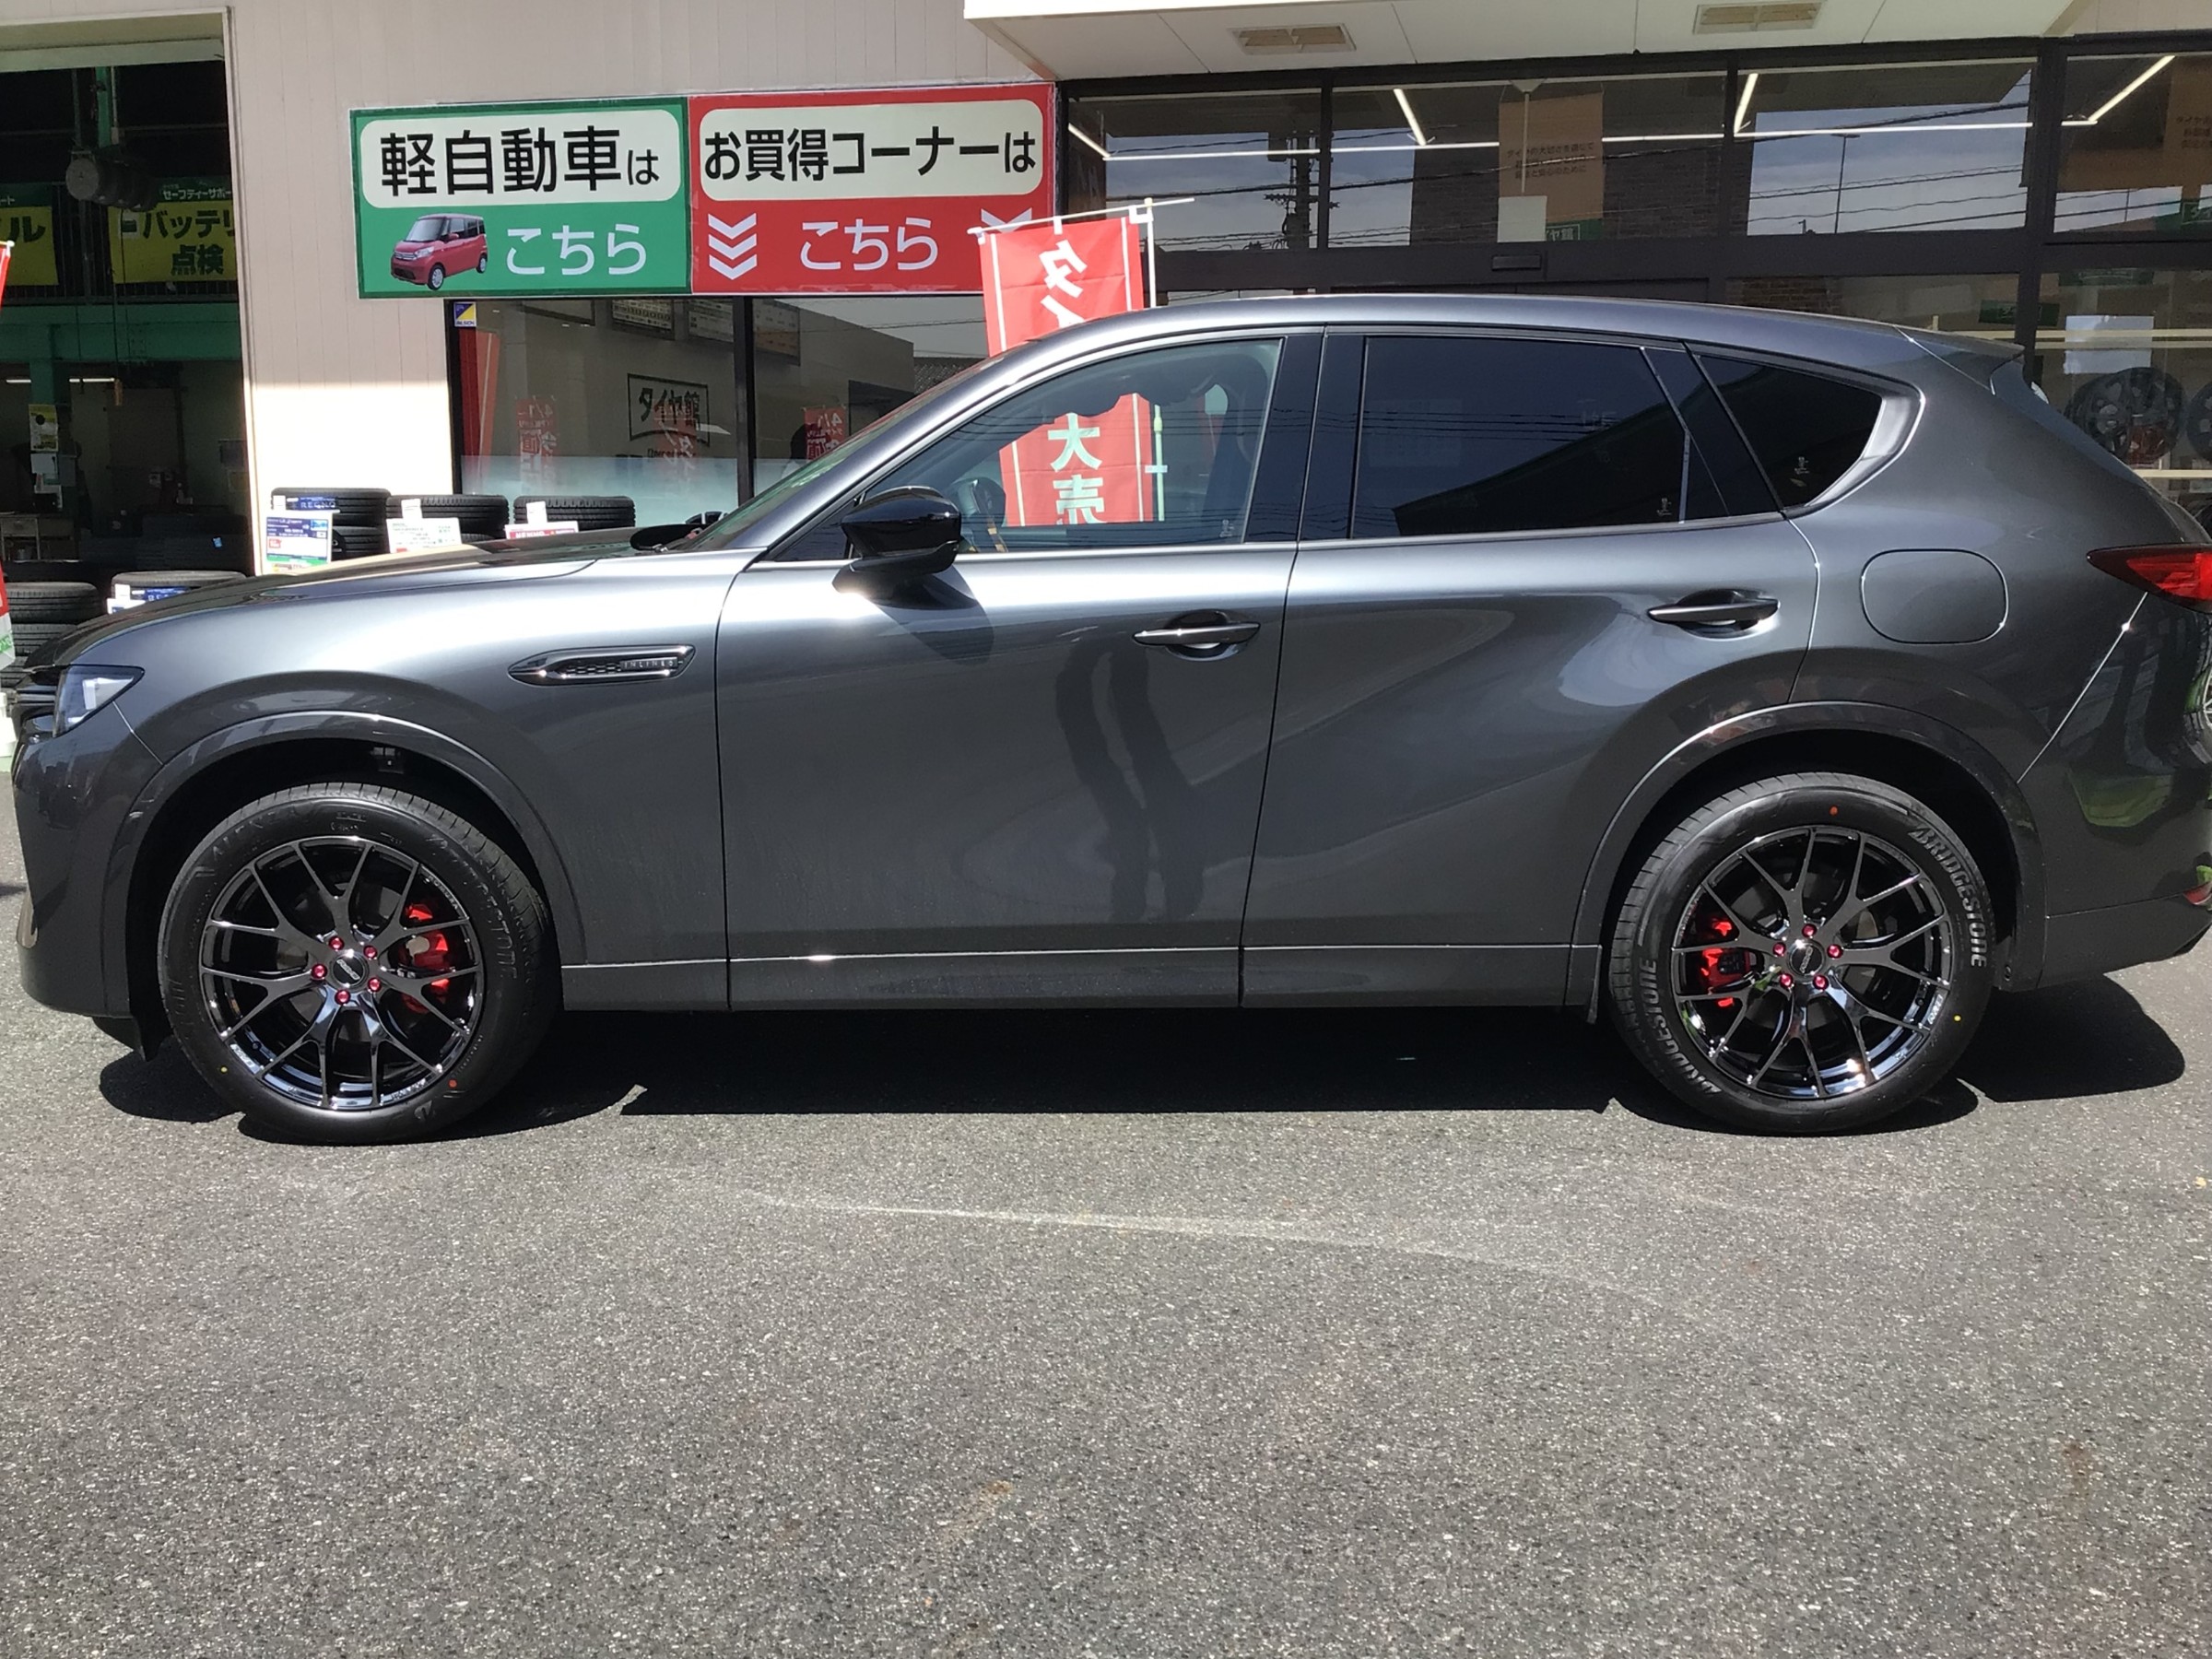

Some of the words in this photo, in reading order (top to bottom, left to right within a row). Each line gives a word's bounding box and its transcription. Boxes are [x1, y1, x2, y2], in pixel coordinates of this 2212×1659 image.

[380, 125, 660, 196] 軽自動車は
[704, 127, 1036, 182] お買得コーナーは
[171, 243, 224, 276] 点検
[506, 223, 647, 276] こちら
[800, 217, 939, 271] こちら
[1908, 826, 1987, 967] BRIDGESTONE
